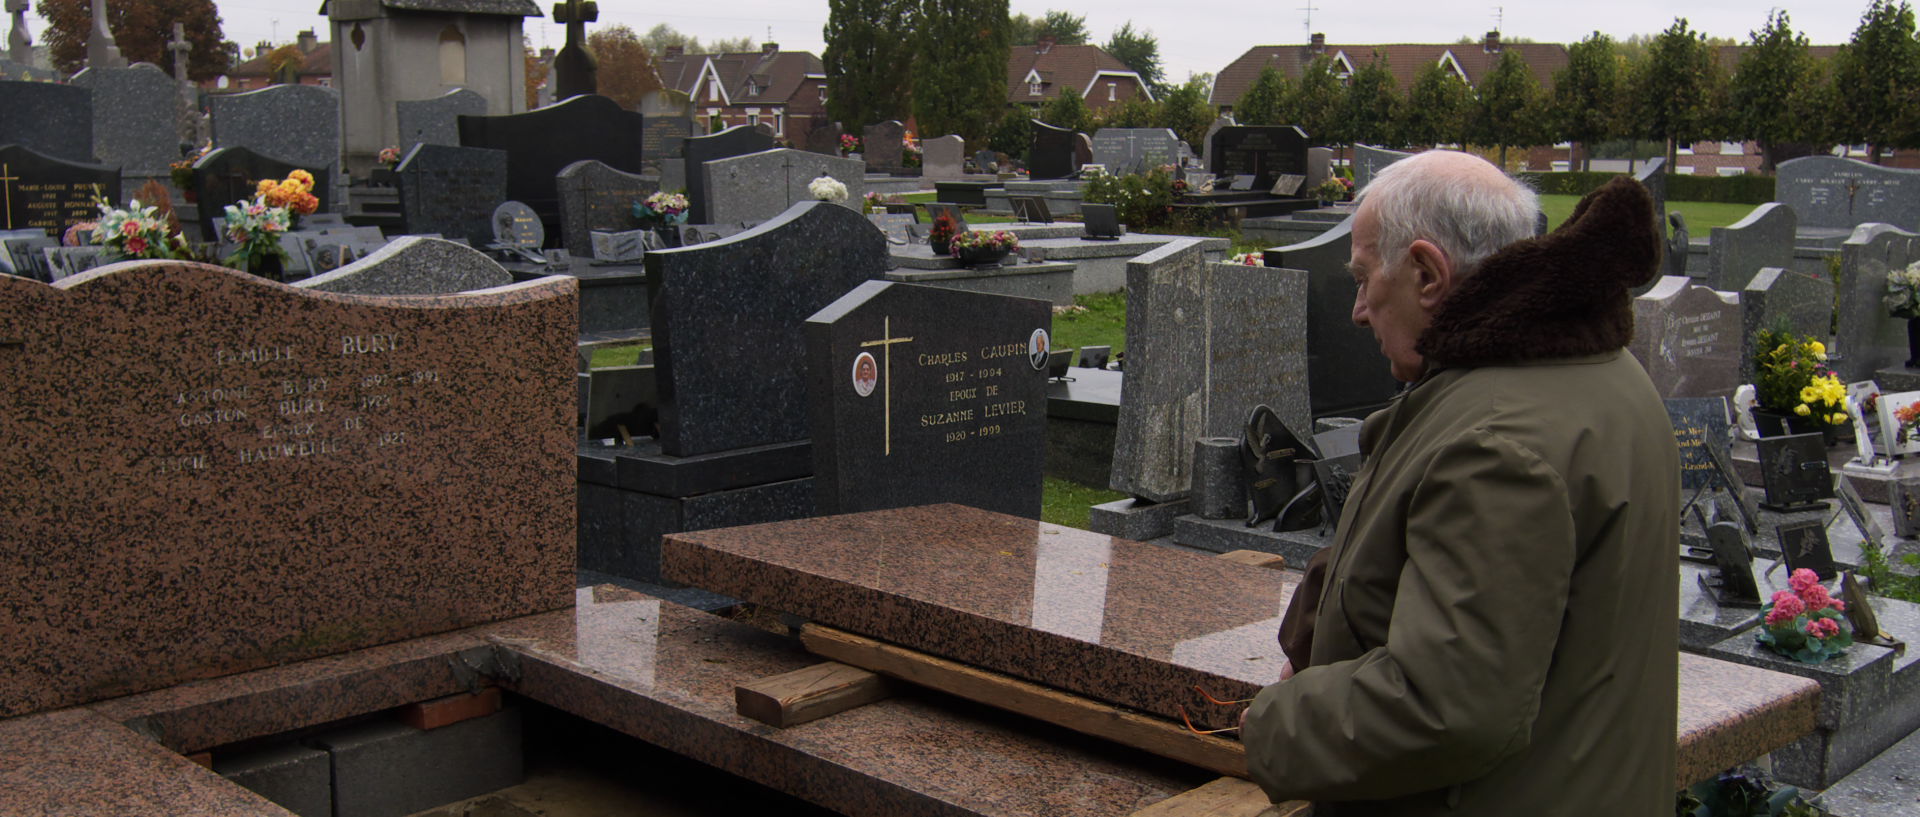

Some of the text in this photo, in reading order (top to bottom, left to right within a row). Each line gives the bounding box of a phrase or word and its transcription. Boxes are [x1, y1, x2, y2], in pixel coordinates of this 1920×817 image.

[342, 331, 400, 355] BURY
[918, 342, 1028, 366] CHARLES CAUPIN
[283, 377, 329, 395] BURY
[945, 371, 965, 383] 1917
[950, 385, 999, 402] EPOUX DE
[180, 407, 248, 427] GASTON
[279, 399, 325, 416] BURY
[920, 400, 1027, 427] SUZANNE LEVIER
[344, 416, 363, 431] DE
[946, 431, 966, 443] 1920
[979, 424, 1001, 437] 1999
